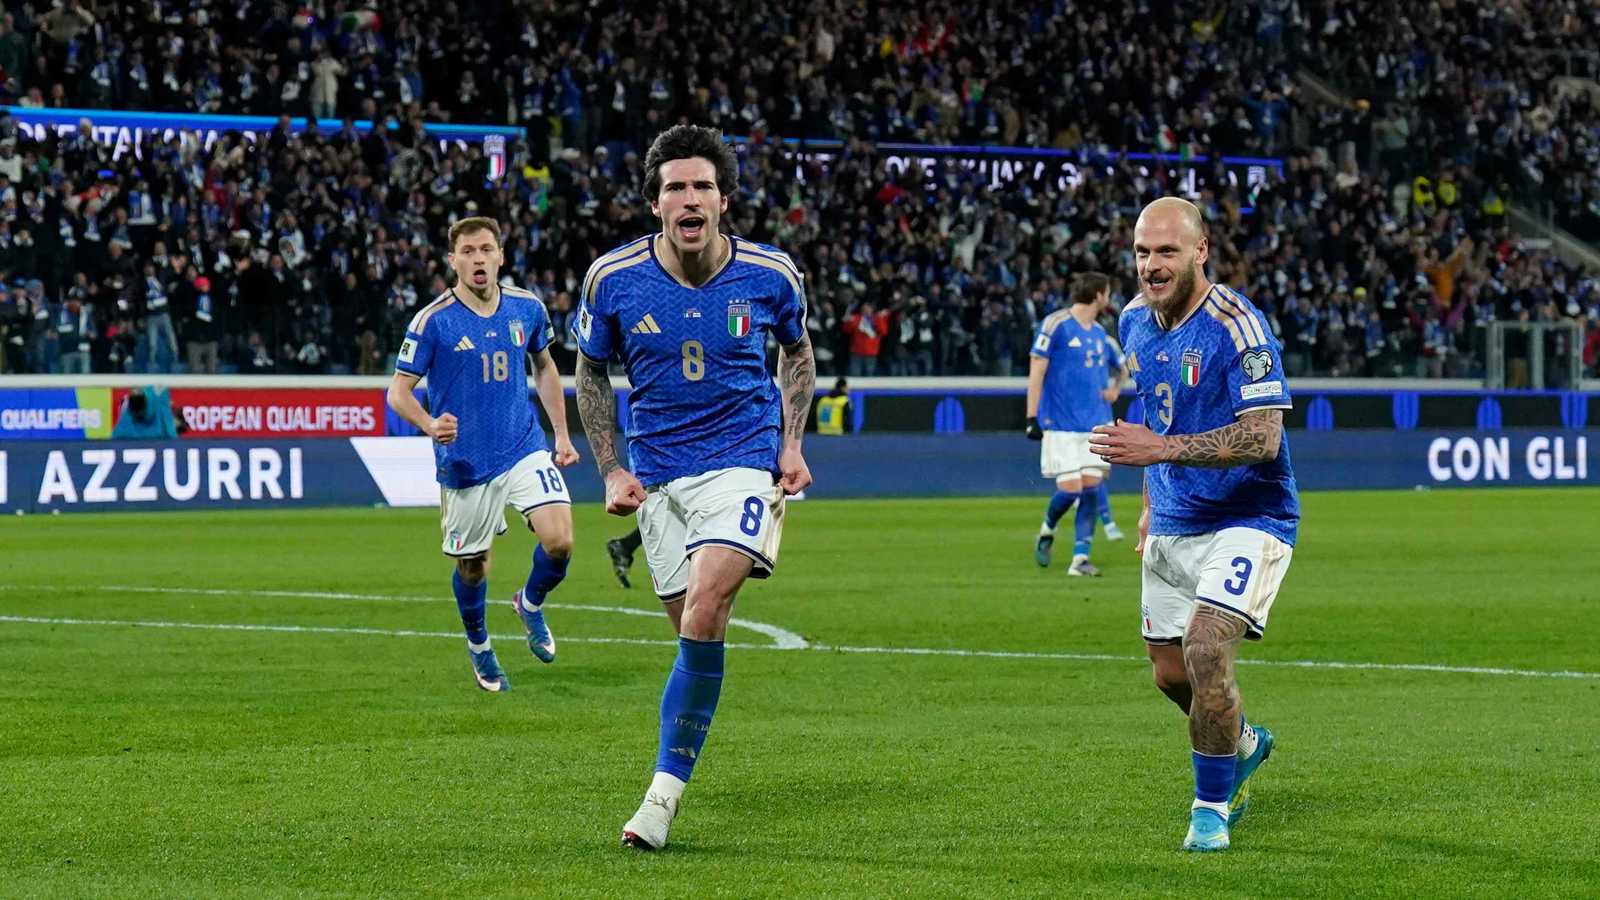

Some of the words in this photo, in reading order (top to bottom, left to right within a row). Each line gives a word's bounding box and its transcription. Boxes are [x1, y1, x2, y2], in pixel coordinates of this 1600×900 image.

[481, 351, 510, 384] 18
[681, 340, 705, 382] 8
[1, 408, 102, 430] QUALIFIERS
[183, 406, 262, 430] ROPEAN
[267, 406, 376, 431] QUALIFIERS
[1155, 382, 1173, 426] 3
[38, 448, 304, 504] AZZURRI
[1427, 436, 1510, 481] CON
[1526, 436, 1588, 480] GLI
[536, 467, 563, 494] 18
[740, 496, 764, 537] 8
[1223, 556, 1253, 597] 3
